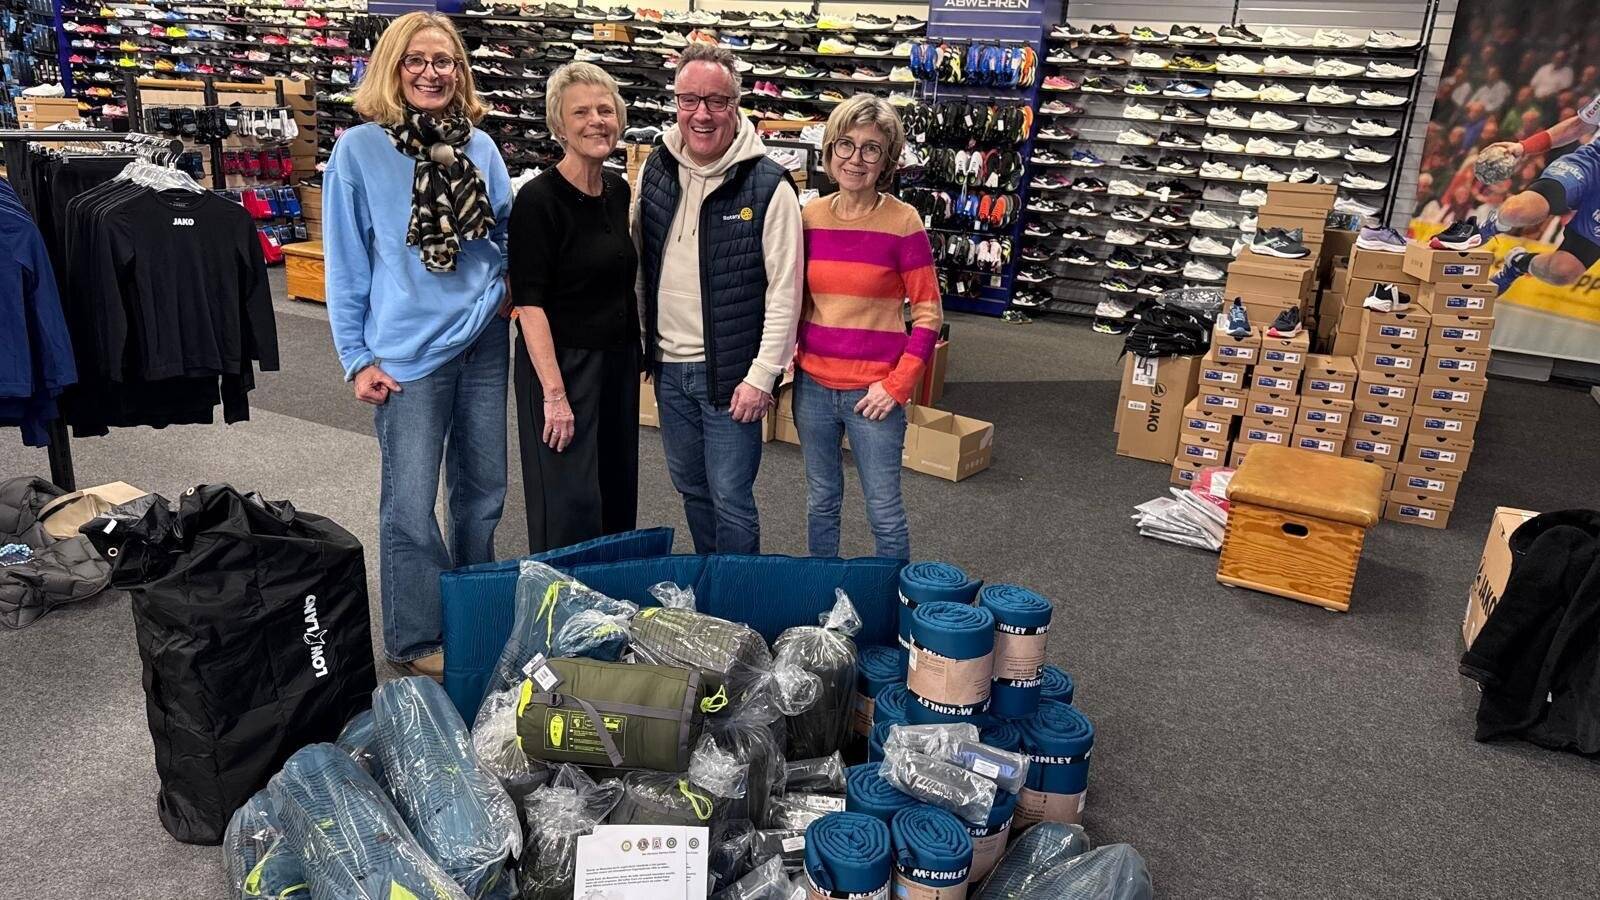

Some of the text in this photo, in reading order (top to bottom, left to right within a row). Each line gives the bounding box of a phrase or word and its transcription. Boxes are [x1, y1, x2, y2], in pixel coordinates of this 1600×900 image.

[944, 0, 1030, 9] ABWEHREN
[172, 217, 195, 226] JAKO
[1146, 400, 1162, 433] JAKO
[303, 594, 328, 678] LOW LAND
[917, 696, 973, 716] McKINLEY
[912, 866, 969, 880] McKINLEY
